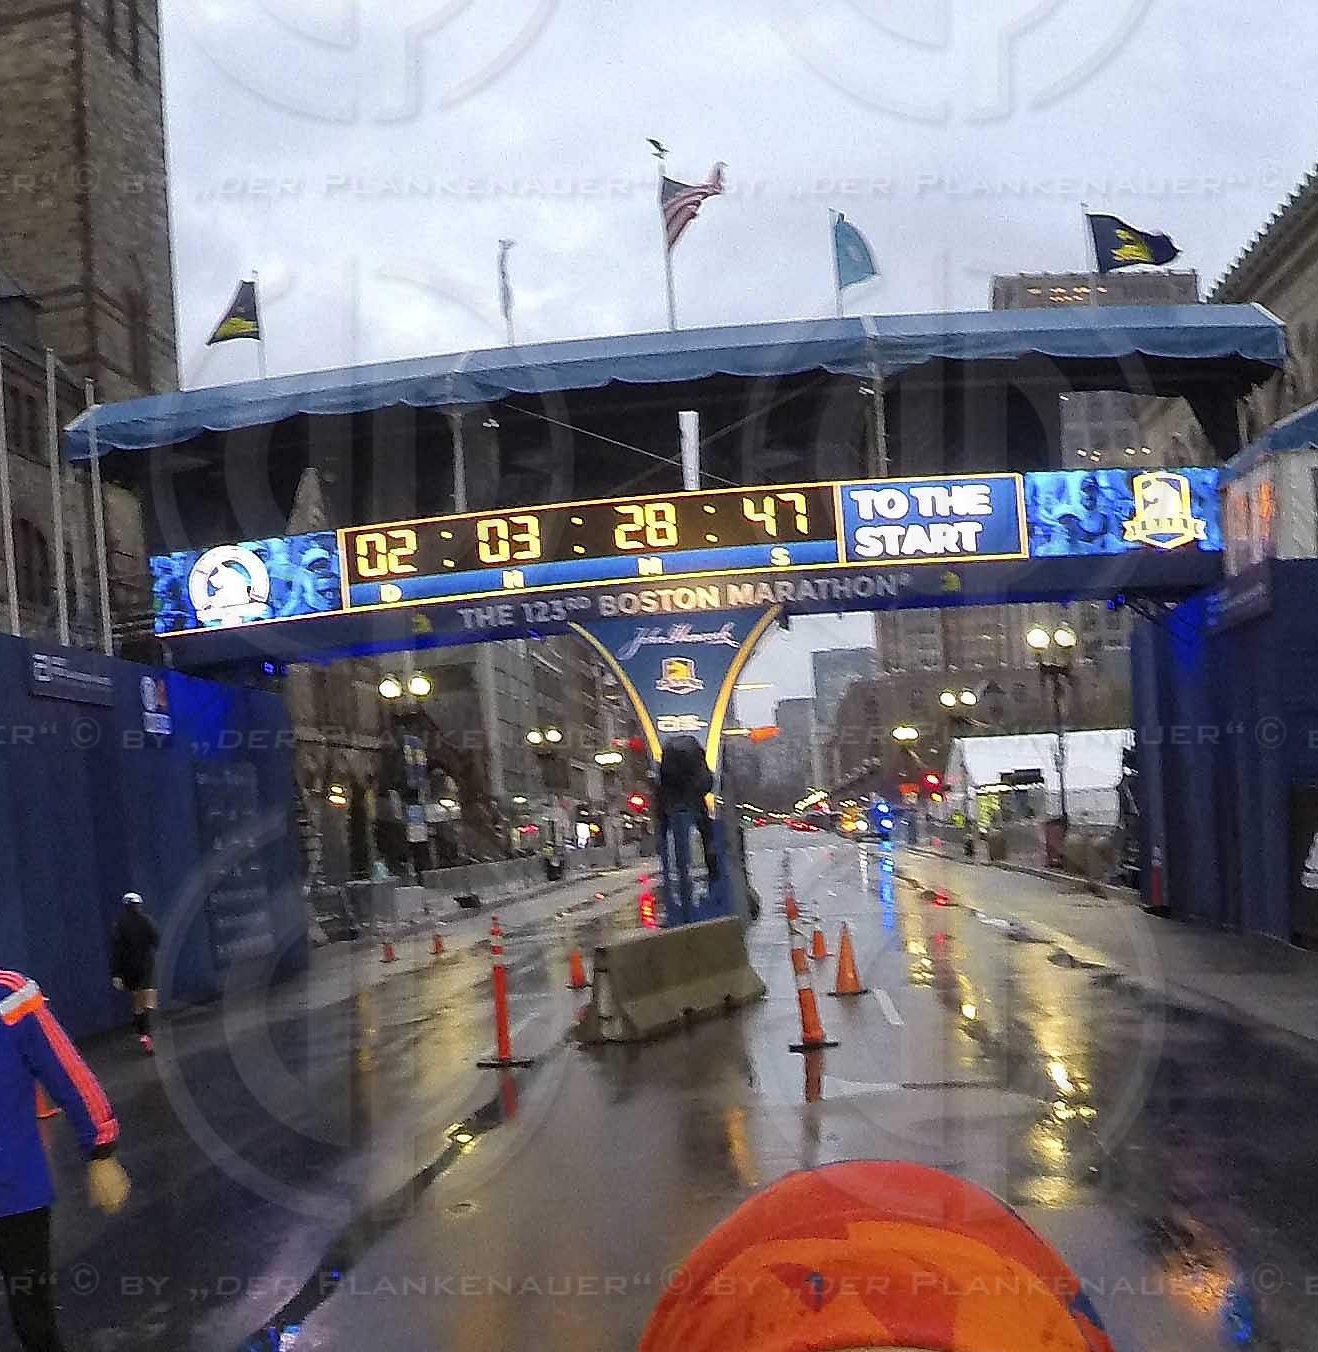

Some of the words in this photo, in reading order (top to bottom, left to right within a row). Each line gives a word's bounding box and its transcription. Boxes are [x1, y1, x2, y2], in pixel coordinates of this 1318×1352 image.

[849, 487, 910, 521] TO
[909, 484, 993, 517] THE
[355, 529, 418, 577] 02
[476, 515, 541, 563] 03
[613, 502, 679, 550] 28
[742, 492, 810, 537] 47
[854, 521, 984, 557] START
[380, 584, 403, 603] D
[636, 556, 664, 576] M
[770, 547, 791, 567] S
[457, 603, 514, 630] THE
[598, 585, 722, 617] BOSTON
